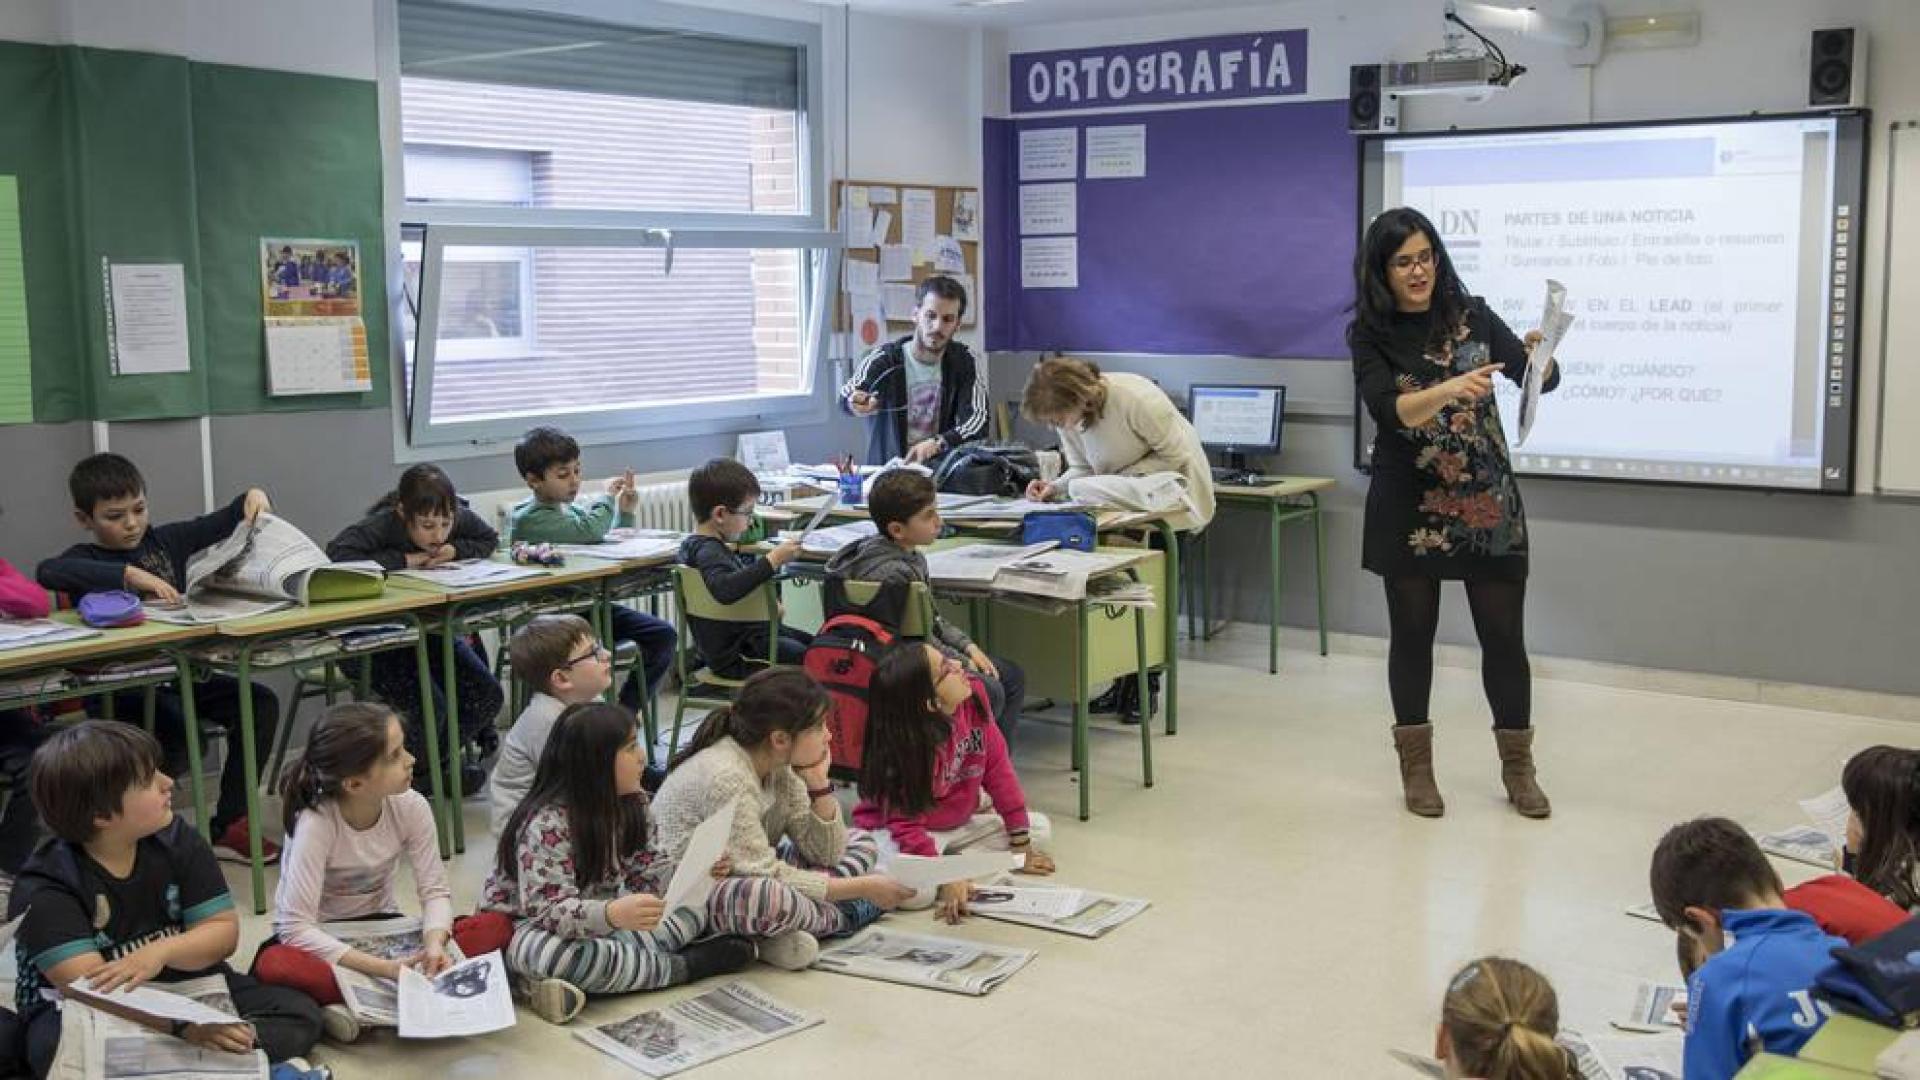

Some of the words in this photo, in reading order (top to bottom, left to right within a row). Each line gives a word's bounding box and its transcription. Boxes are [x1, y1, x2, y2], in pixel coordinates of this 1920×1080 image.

[1504, 211, 1561, 225] PARTES
[1568, 211, 1590, 225] DE
[1594, 210, 1627, 225] UNA
[1631, 208, 1695, 224] NOTICIA
[1719, 233, 1785, 246] resumen
[1662, 252, 1681, 265] de
[1588, 299, 1608, 312] EN
[1619, 299, 1637, 312] EL
[1650, 299, 1692, 312] LEAD
[1734, 302, 1783, 314] primer
[1641, 319, 1660, 332] de
[1664, 319, 1676, 331] la
